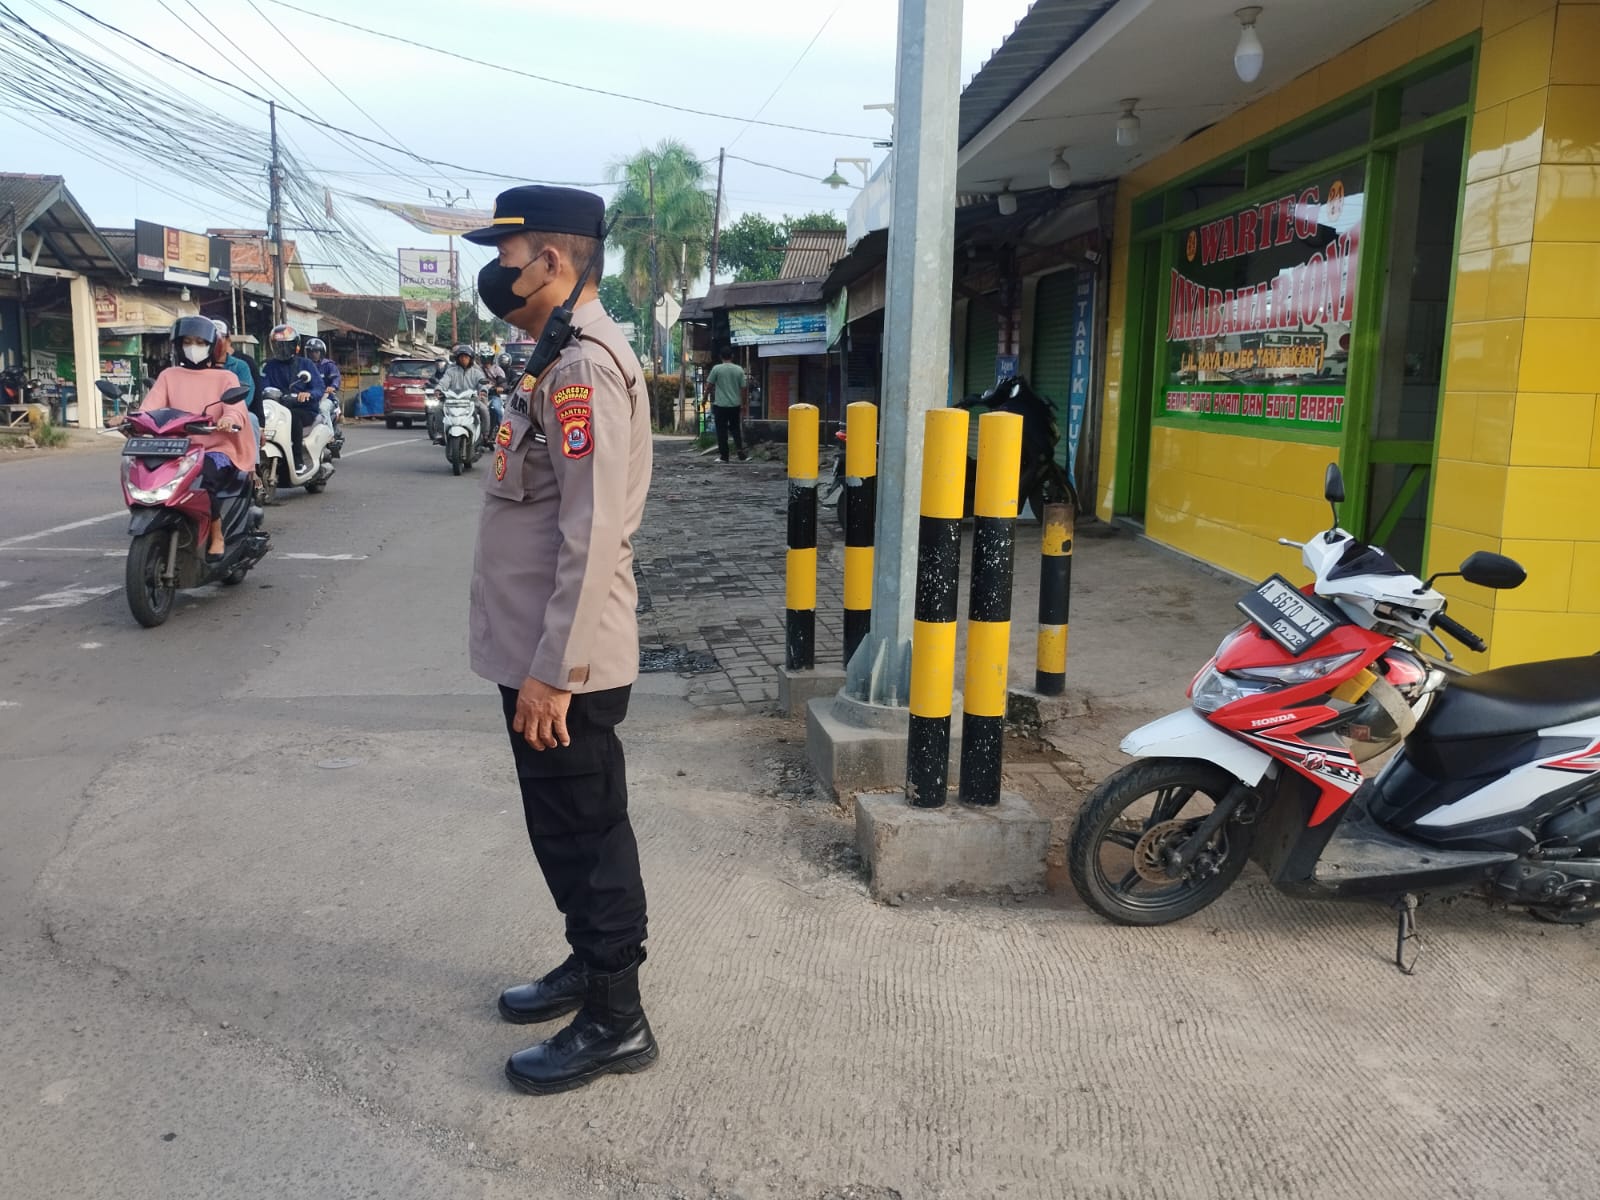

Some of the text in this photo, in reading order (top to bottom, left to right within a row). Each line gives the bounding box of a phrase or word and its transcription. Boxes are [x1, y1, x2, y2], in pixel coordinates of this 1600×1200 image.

[1199, 186, 1320, 266] WARTEG
[1073, 301, 1089, 394] TARIK
[1198, 351, 1220, 370] RAYA
[1222, 349, 1254, 369] RAJEG
[554, 387, 589, 401] POLRESTA
[1189, 391, 1212, 413] SOTO
[1212, 392, 1240, 416] AYAM
[1241, 393, 1264, 417] DAN
[1265, 393, 1297, 419] SOTO
[1298, 395, 1344, 423] BABAT
[560, 408, 588, 418] BANTEN
[1257, 583, 1275, 596] A
[1271, 592, 1303, 618] 6670
[1251, 713, 1297, 727] HONDA
